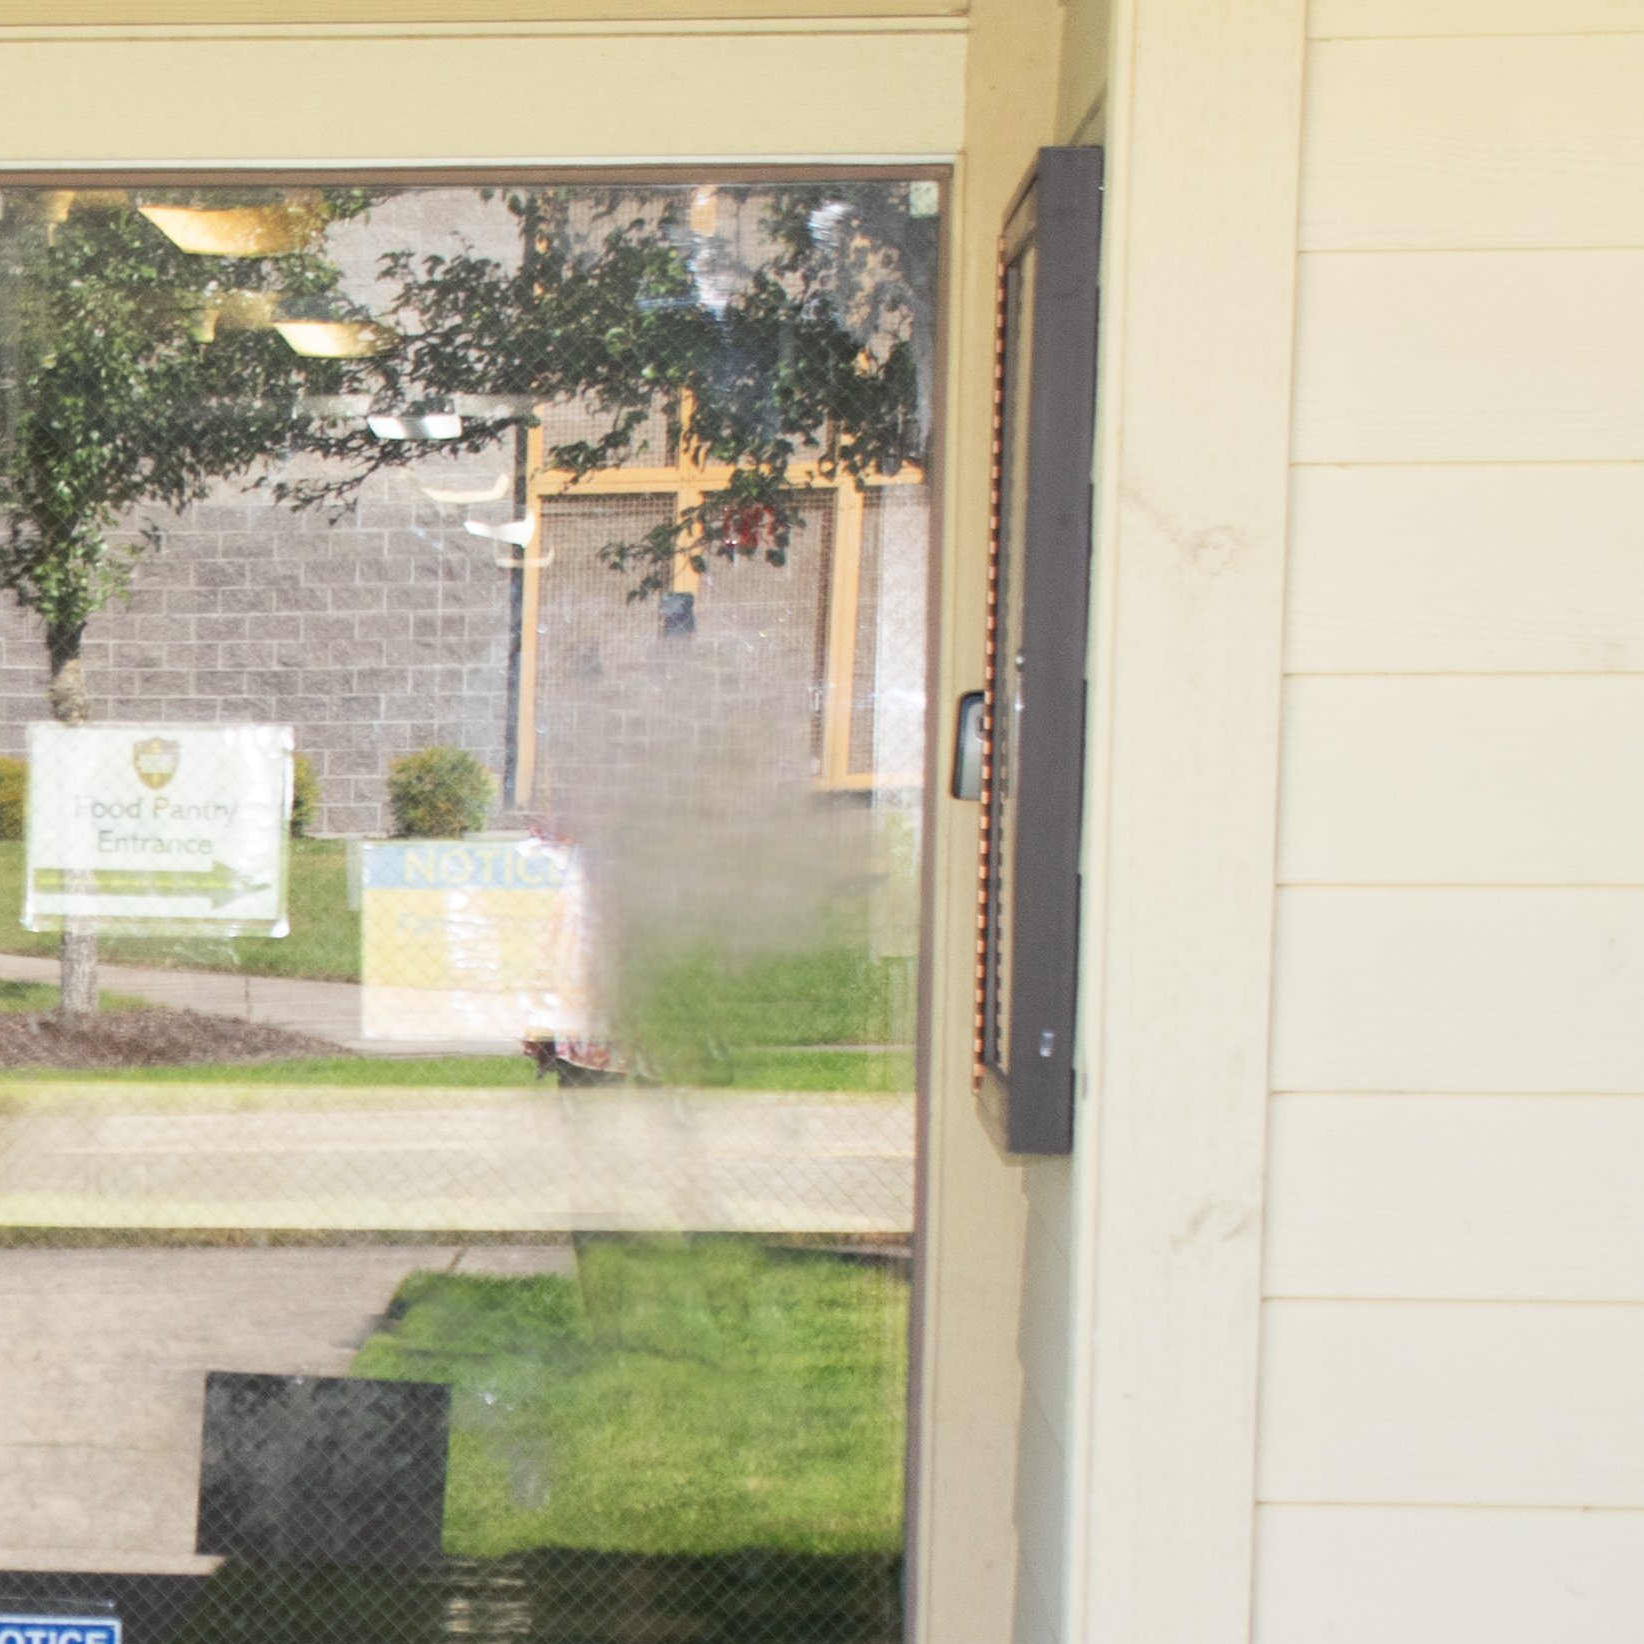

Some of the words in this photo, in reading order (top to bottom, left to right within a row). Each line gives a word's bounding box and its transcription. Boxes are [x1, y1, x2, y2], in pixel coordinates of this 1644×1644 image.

[74, 795, 142, 819] Food
[152, 797, 239, 828] Pantry
[98, 829, 213, 855] Entrance
